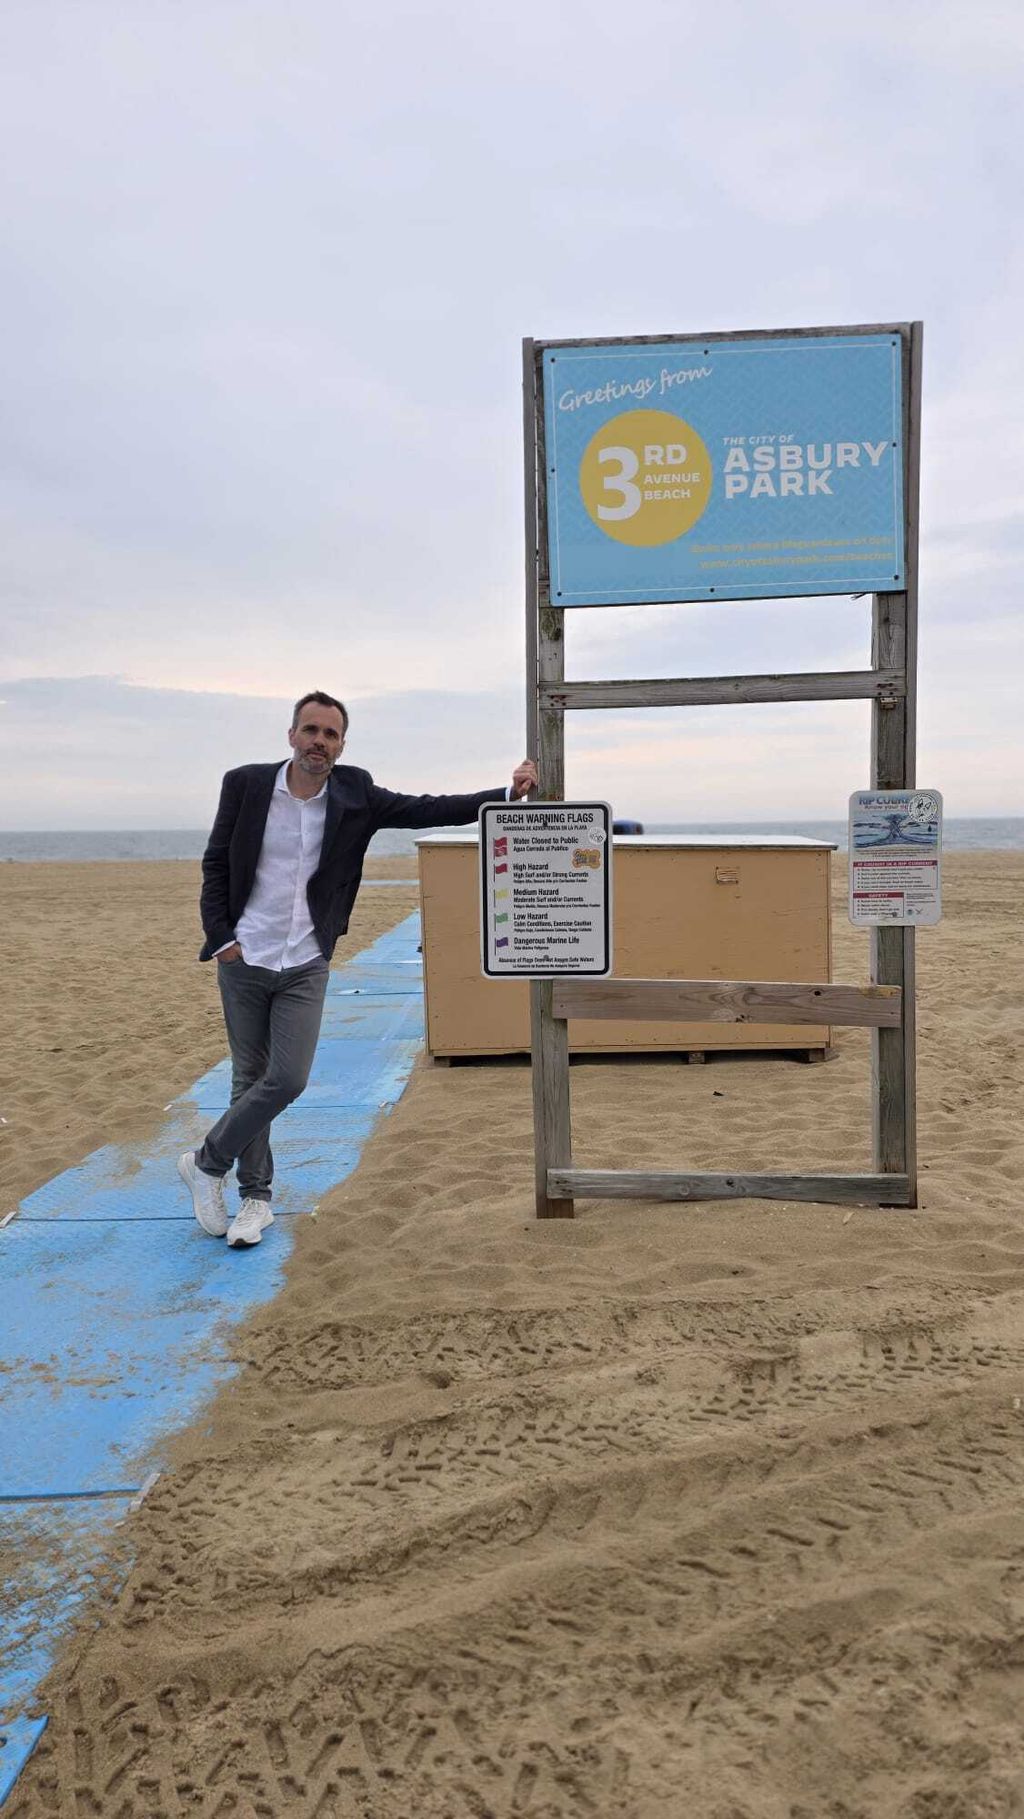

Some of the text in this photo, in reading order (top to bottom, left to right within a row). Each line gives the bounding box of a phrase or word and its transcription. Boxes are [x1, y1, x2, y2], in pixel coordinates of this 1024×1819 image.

[558, 365, 714, 412] Greetings from
[722, 434, 796, 446] THE CITY OF
[722, 440, 889, 474] ASBURY
[643, 472, 701, 485] AVENUE
[724, 470, 834, 499] PARK
[643, 488, 691, 501] BEACH
[496, 812, 594, 824] BEACH WARNING FLAGS
[512, 837, 530, 845] Water
[560, 836, 579, 844] Public
[512, 863, 549, 872] High Hazard
[513, 888, 560, 896] Medium Hazard
[527, 912, 549, 920] Hazard
[513, 936, 580, 946] Dangerous Marine Life
